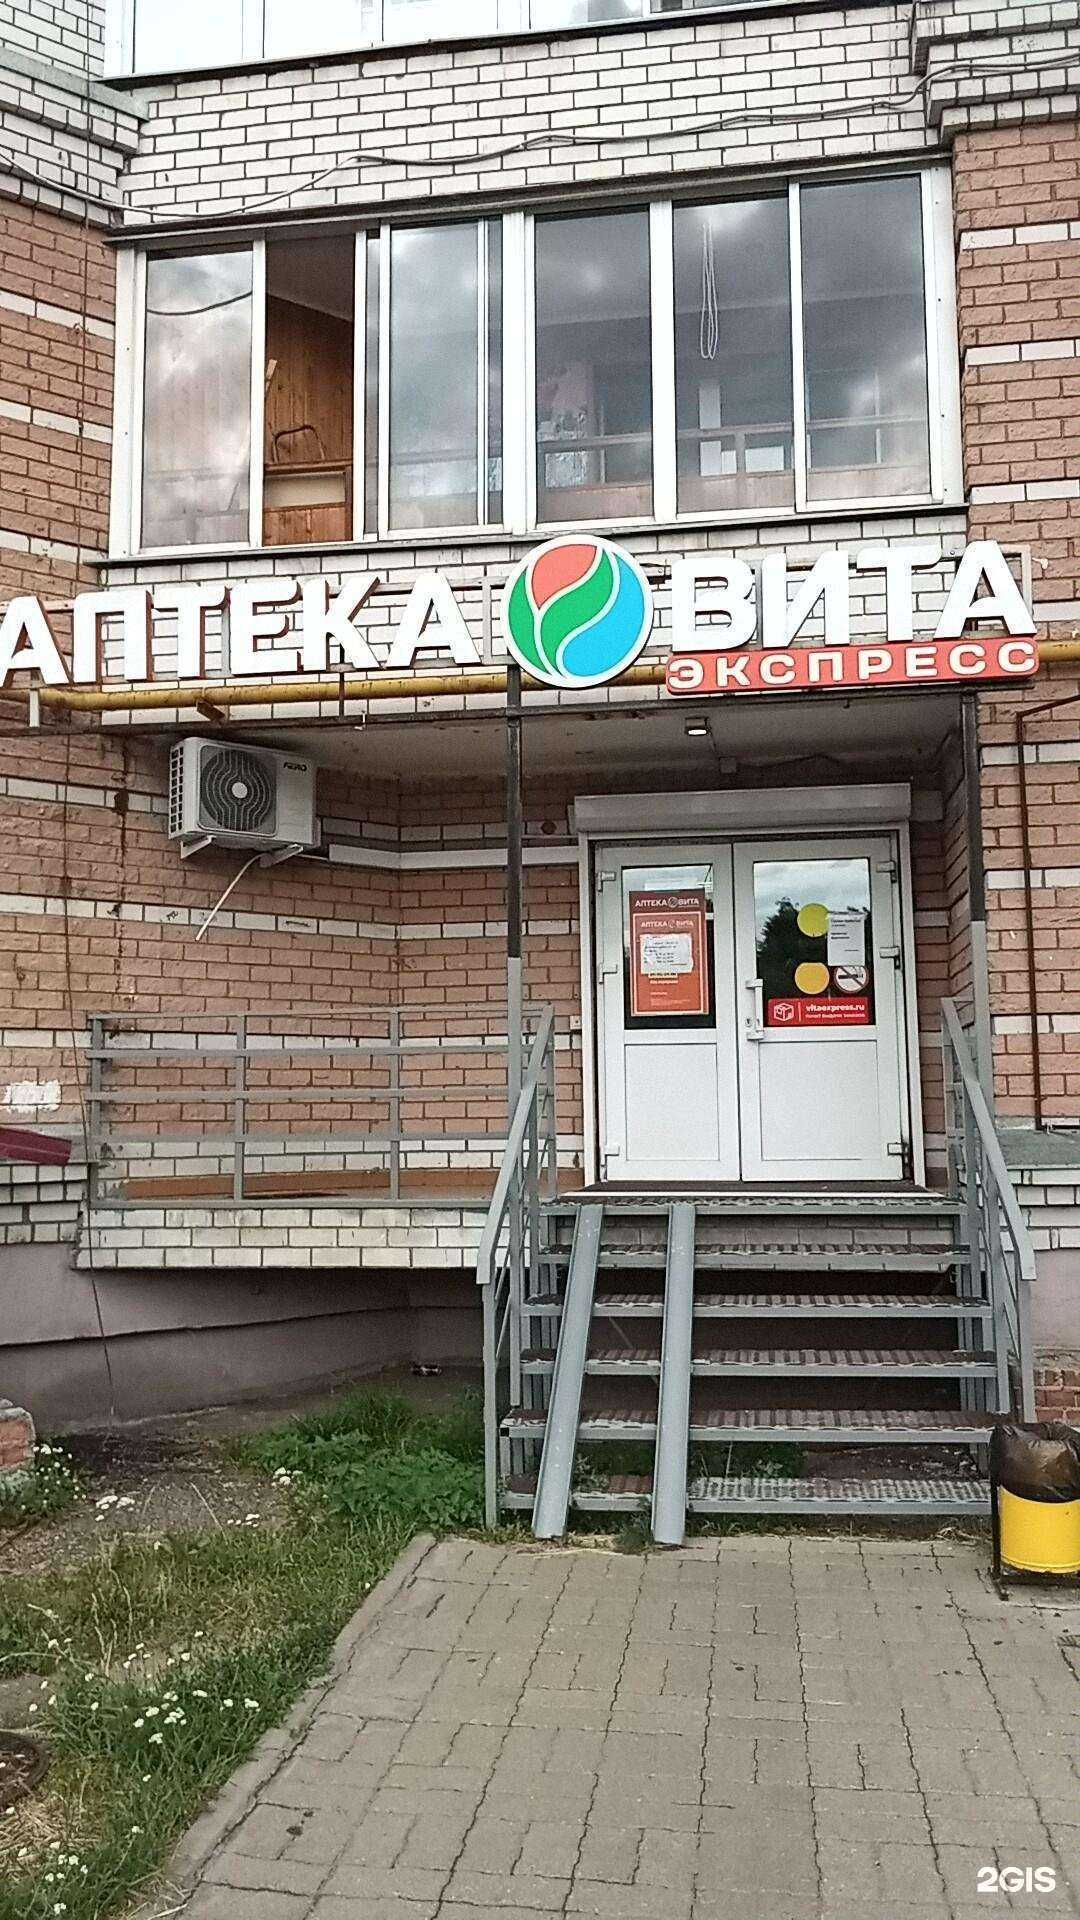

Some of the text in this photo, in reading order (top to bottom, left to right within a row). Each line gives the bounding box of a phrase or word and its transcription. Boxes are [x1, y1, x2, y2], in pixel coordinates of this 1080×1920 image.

[0, 540, 1038, 687] АПТЕКА ВИТА
[667, 640, 1038, 688] ЭКСПРЕСС
[635, 899, 668, 907] АПТЕКА
